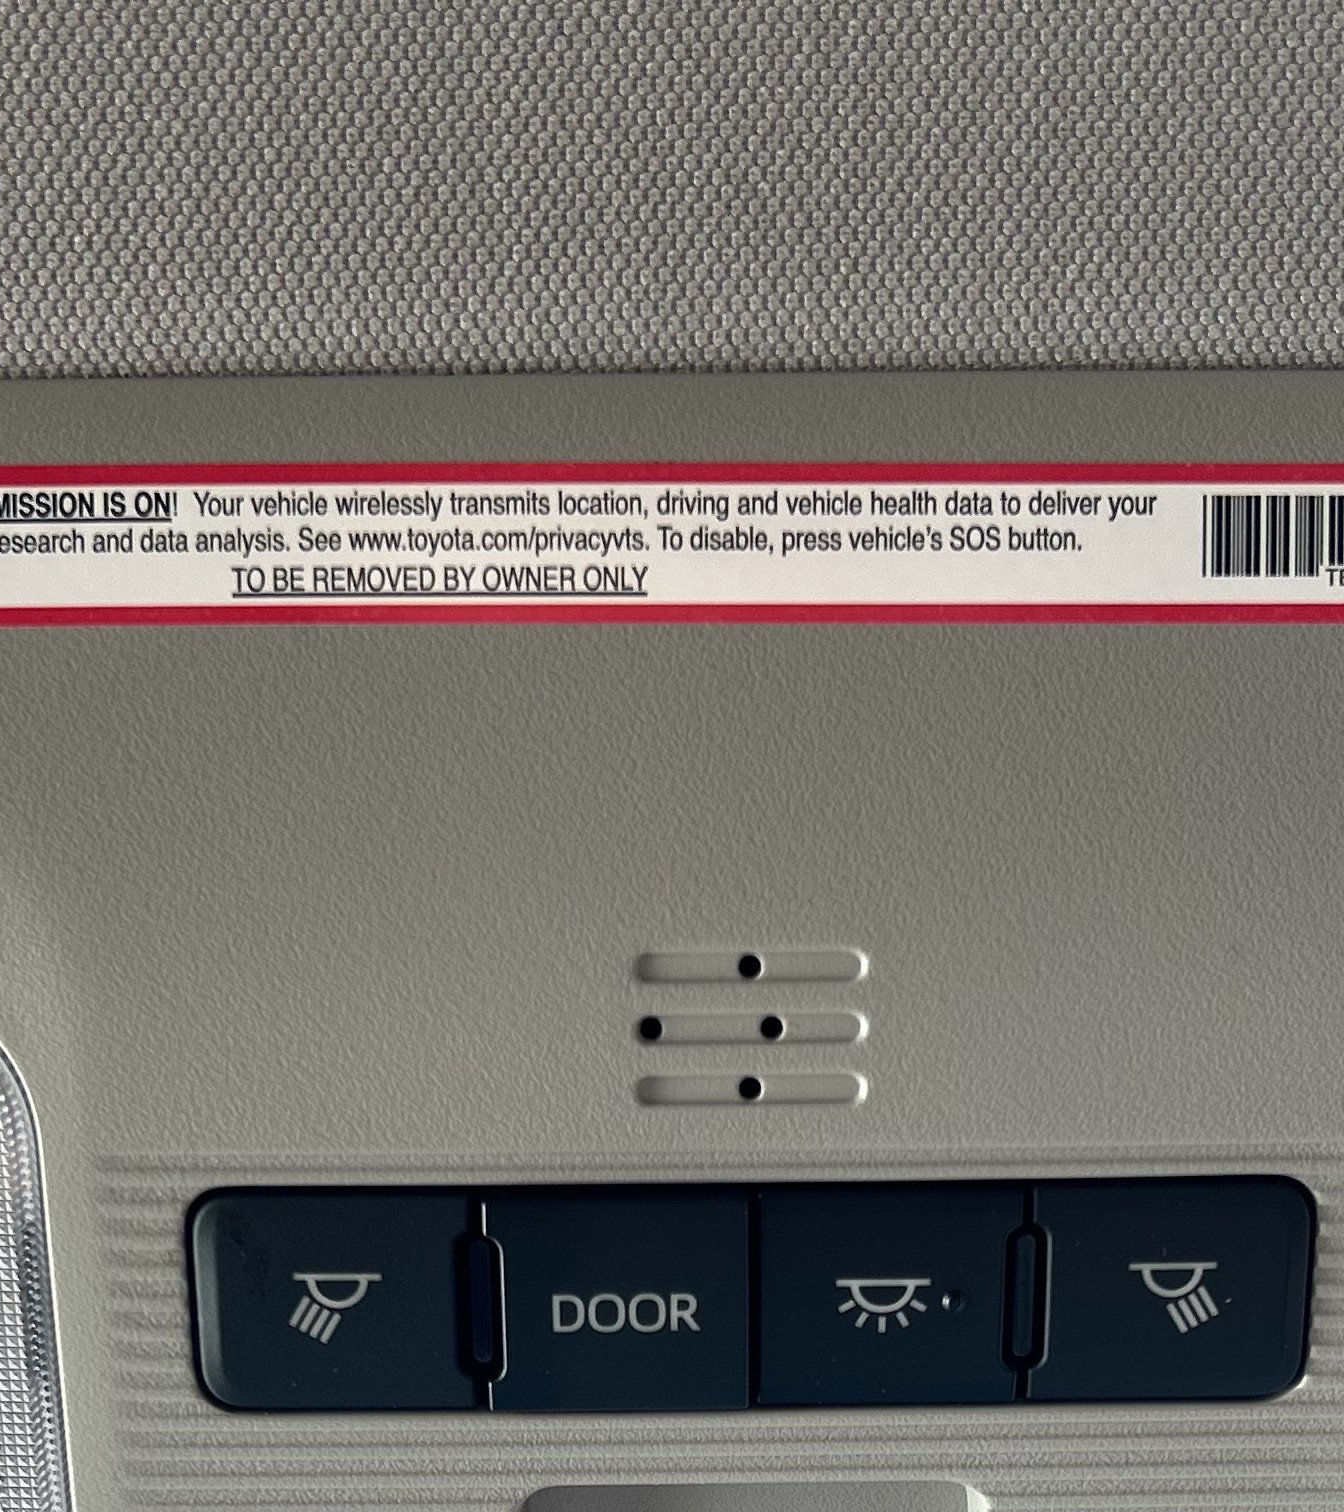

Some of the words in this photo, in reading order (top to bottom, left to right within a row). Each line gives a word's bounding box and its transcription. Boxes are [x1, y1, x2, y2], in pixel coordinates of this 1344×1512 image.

[103, 490, 127, 518] IS
[134, 490, 178, 518] ON!
[193, 490, 245, 517] Your
[250, 490, 328, 517] vehicle
[334, 490, 443, 522] wirelessly
[449, 490, 551, 516] transmits
[558, 489, 648, 520] location,
[656, 489, 729, 522] driving
[737, 489, 778, 516] and
[785, 489, 863, 516] vehicle
[870, 489, 937, 516] health
[944, 490, 993, 517] data
[999, 491, 1021, 516] to
[1028, 489, 1102, 516] deliver
[1107, 495, 1158, 522] your
[92, 528, 134, 554] and
[140, 527, 189, 553] data
[195, 527, 291, 559] analysis.
[298, 526, 342, 552] See
[348, 526, 650, 558] www.toyota.com/privacyvts.
[656, 525, 683, 551] To
[689, 525, 774, 555] disable,
[781, 531, 842, 557] press
[847, 525, 943, 552] vehicle's
[949, 524, 1001, 552] SOS
[1008, 525, 1082, 552] button.
[231, 566, 266, 593] TO
[273, 566, 306, 593] BE
[313, 565, 436, 593] REMOVED
[443, 565, 476, 592] BY
[482, 565, 576, 592] OWNER
[583, 565, 649, 592] ONLY
[551, 1293, 701, 1333] DOOR
